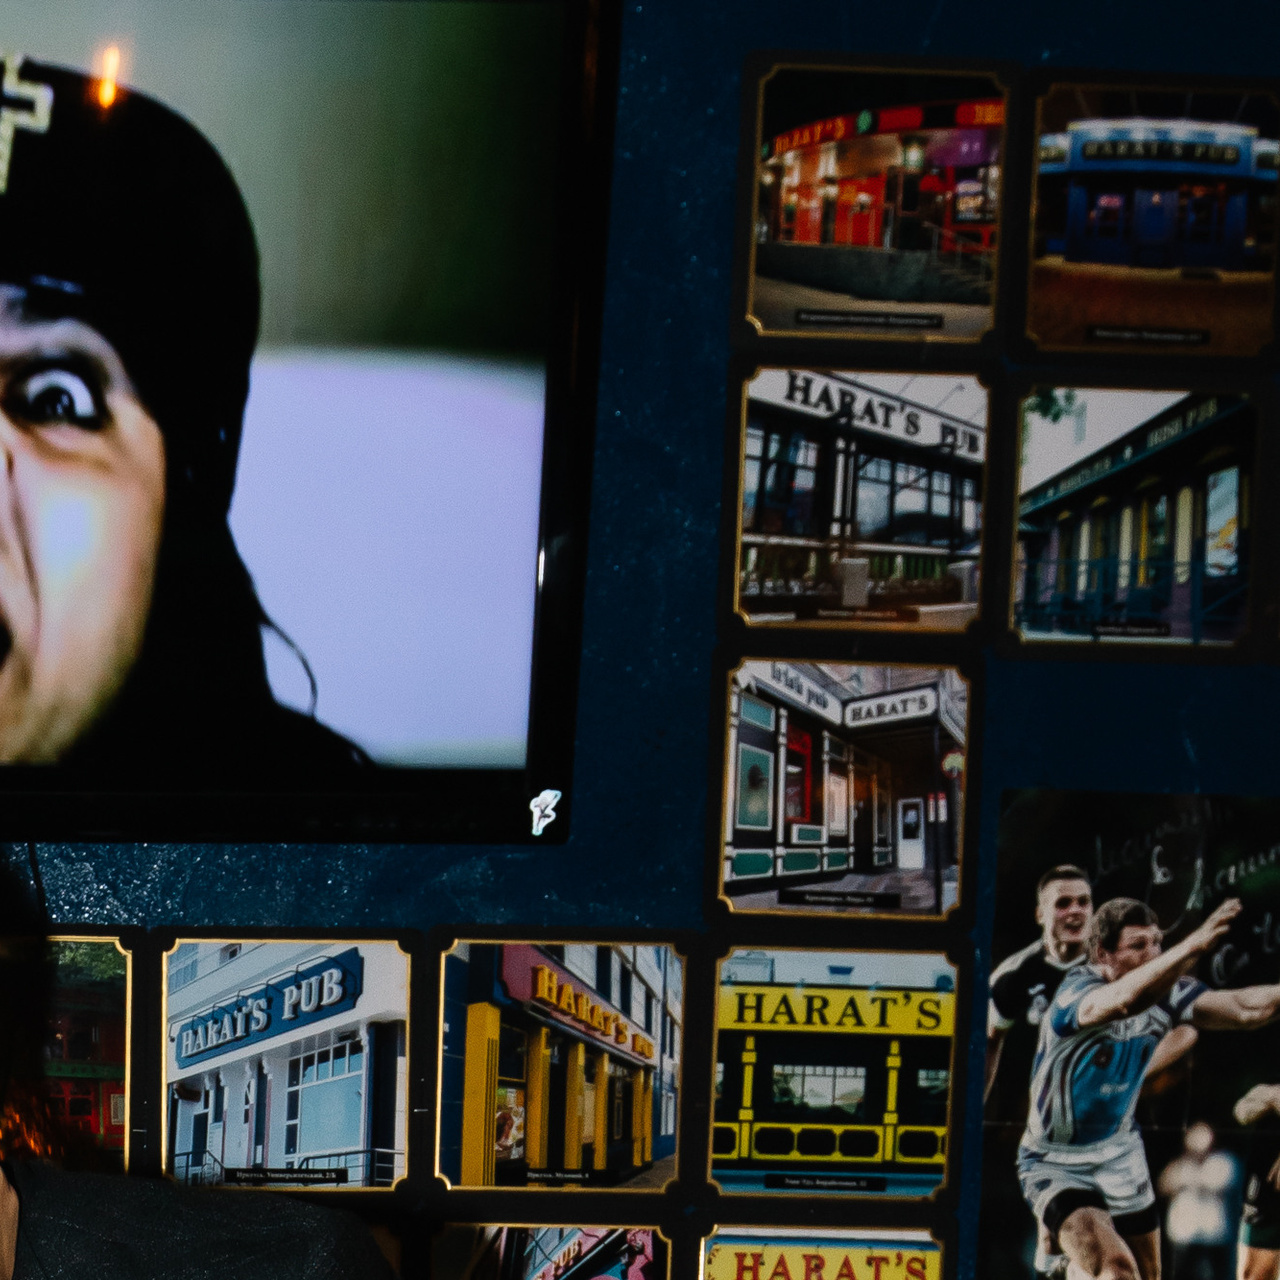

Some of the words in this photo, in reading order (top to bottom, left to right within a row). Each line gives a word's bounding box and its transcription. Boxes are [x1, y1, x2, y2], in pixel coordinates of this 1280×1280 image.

[784, 370, 920, 436] HARAT'S
[852, 695, 928, 721] HARAT'S
[282, 967, 345, 1020] PUB
[534, 964, 628, 1044] HARAT'S
[734, 991, 942, 1029] HARAT'S
